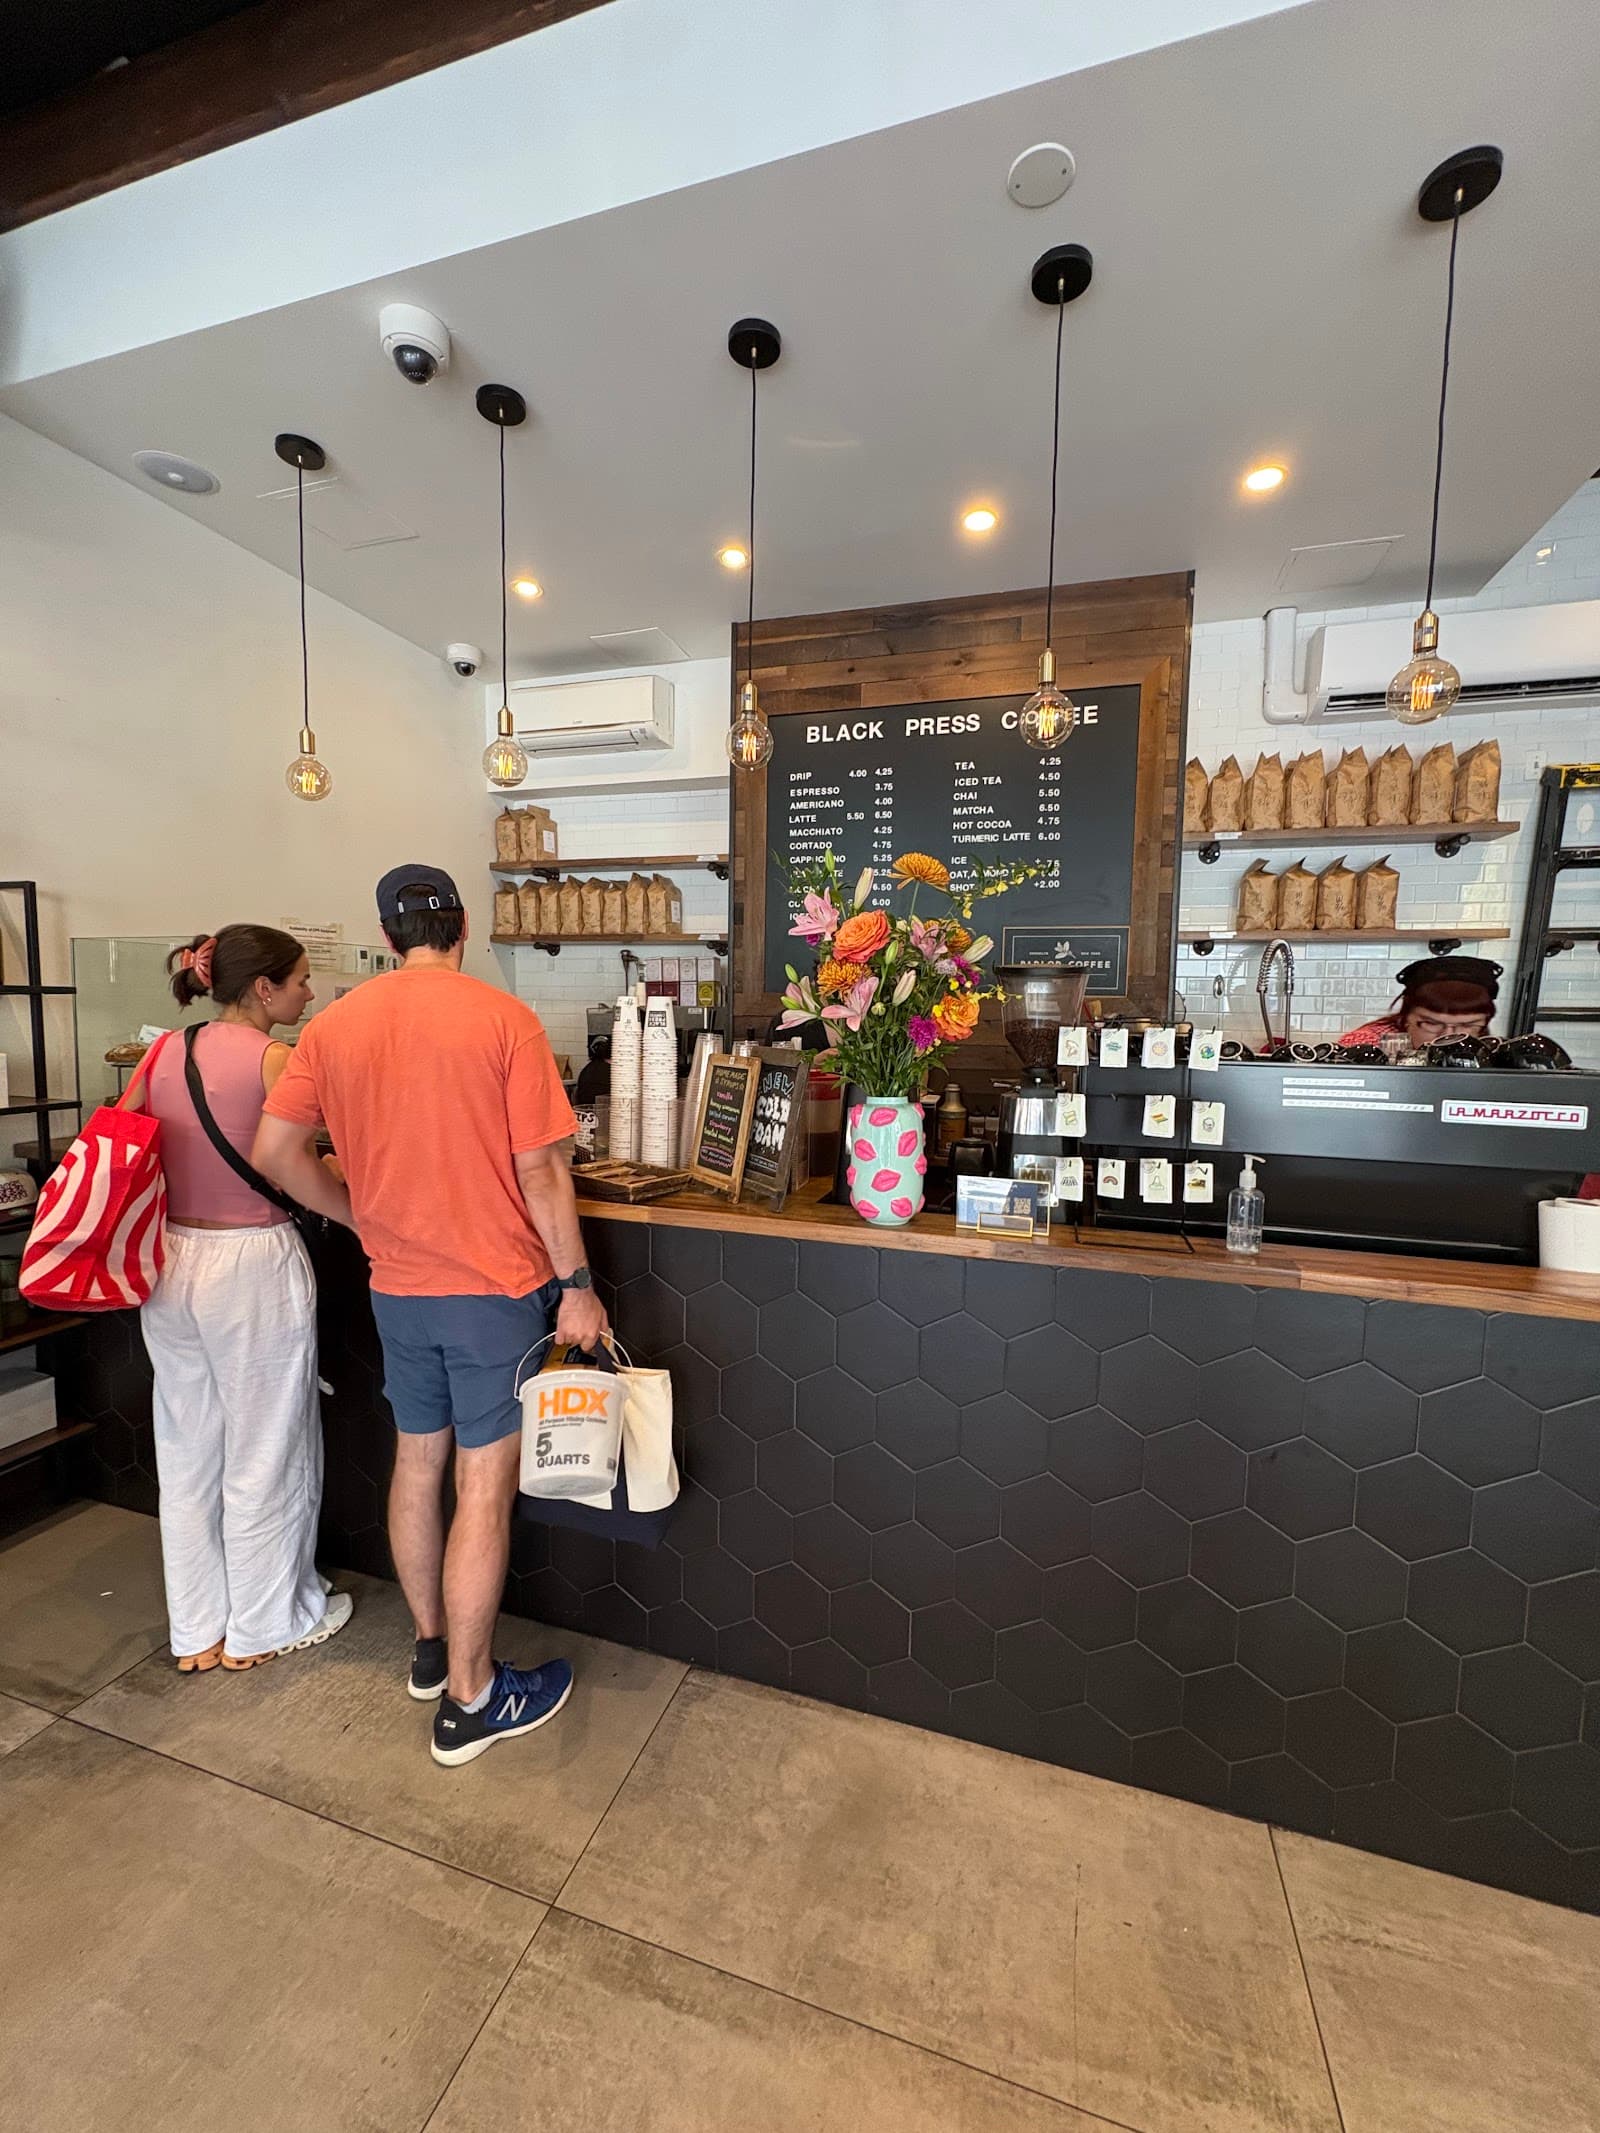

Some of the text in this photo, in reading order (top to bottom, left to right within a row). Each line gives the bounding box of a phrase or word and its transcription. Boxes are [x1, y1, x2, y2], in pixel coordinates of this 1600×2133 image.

[806, 705, 1099, 744] BLACK PRESS COEE
[954, 757, 1061, 770] TEA 4.25
[790, 768, 893, 781] DRIP 4.00 4.25
[954, 772, 1060, 786] ICED TEA 4.50
[790, 783, 893, 796] ESPRESSO 3.75
[953, 788, 1060, 800] CHAI 5.50
[790, 798, 893, 810] AMERICANO 4.00
[952, 804, 1060, 815] MATCHA 6.50
[789, 814, 816, 824] LATTE
[952, 816, 1060, 830] HOT COCOA 4.75
[790, 826, 892, 836] MACCHIATO 4.25
[952, 832, 1060, 843] TURMERIC LATTE 6.00
[790, 840, 892, 850] CORTADO 4.75
[790, 854, 892, 864] CAPPUCNO 5.25
[951, 856, 968, 864] ICE
[950, 880, 1060, 892] SHOT +2.00
[872, 898, 890, 906] 6.00
[1068, 960, 1111, 968] COFFEE
[763, 1072, 794, 1095] NEW
[756, 1096, 792, 1122] COLD
[1449, 1106, 1466, 1116] LA
[538, 1388, 609, 1419] HDX
[536, 1432, 552, 1457] 5
[537, 1454, 590, 1468] QUARTS
[496, 1694, 528, 1722] N
